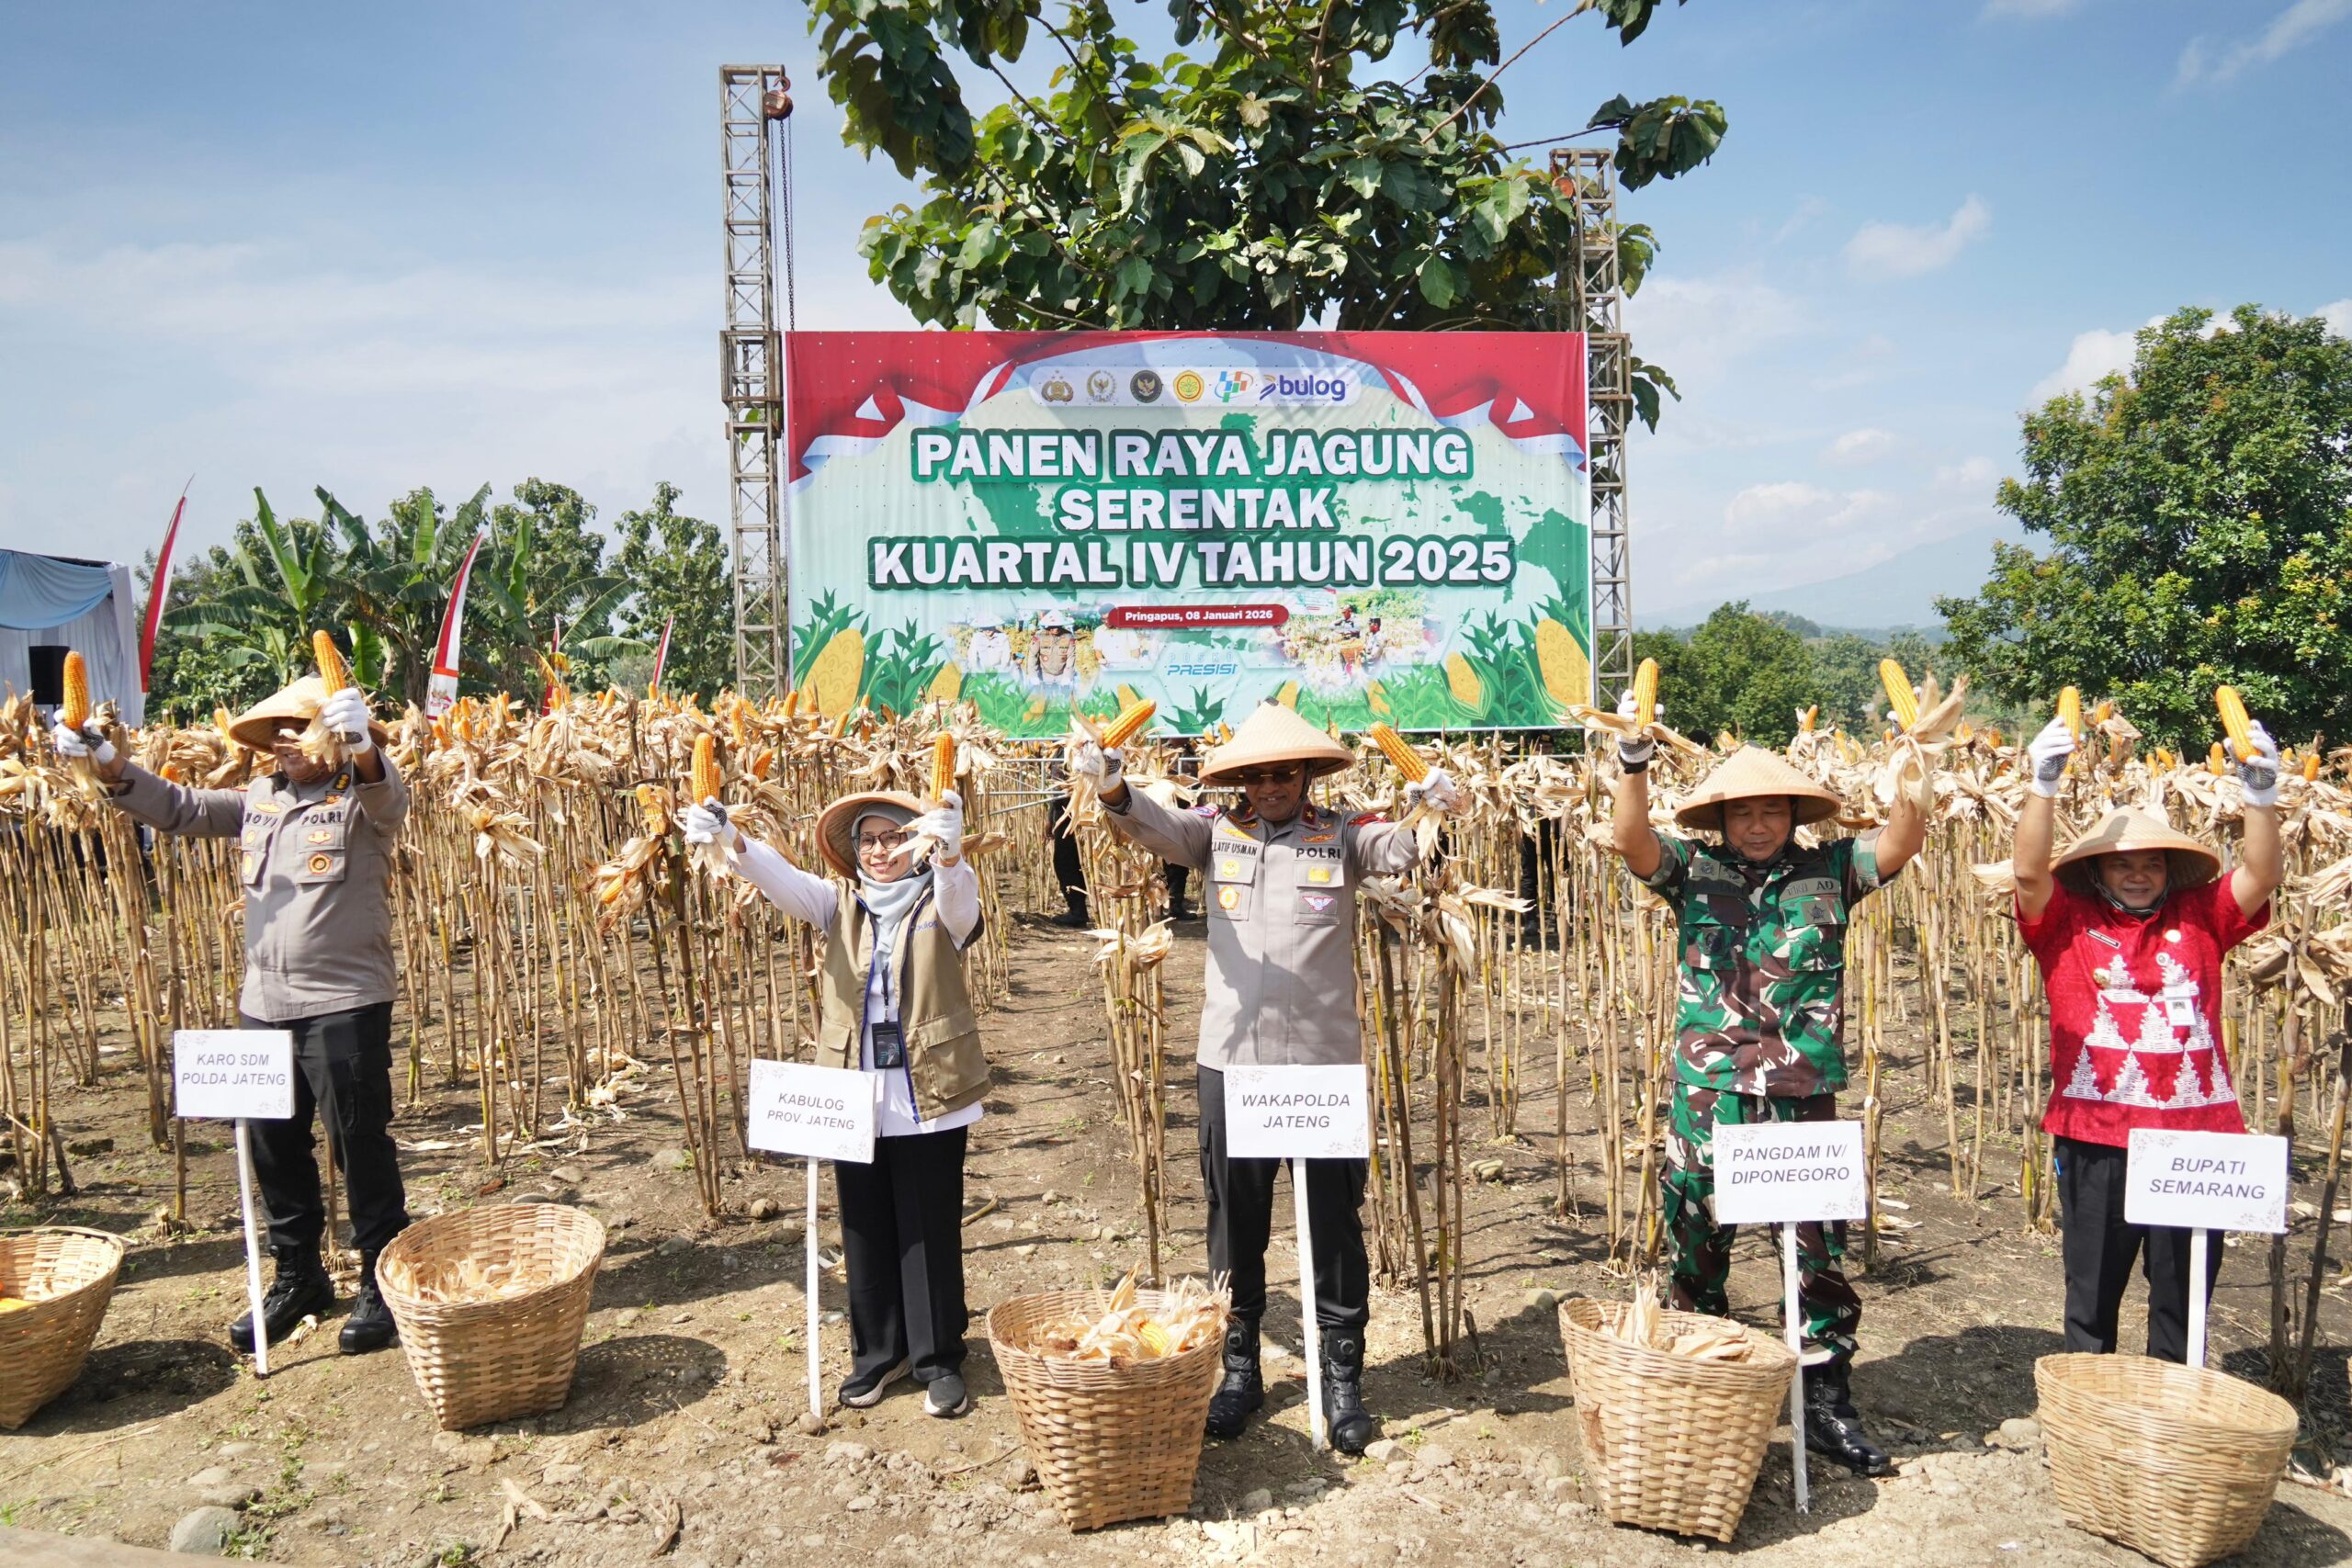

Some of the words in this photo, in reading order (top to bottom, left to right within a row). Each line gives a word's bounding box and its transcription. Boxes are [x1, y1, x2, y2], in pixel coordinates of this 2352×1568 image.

[1279, 375, 1345, 400] bulog
[919, 435, 1096, 476] PANEN
[1116, 435, 1250, 476] RAYA
[1265, 435, 1467, 476] JAGUNG
[1059, 489, 1334, 530] SERENTAK
[875, 543, 1116, 584] KUARTAL
[1133, 543, 1184, 582] IV
[1198, 542, 1367, 582] TAHUN
[1385, 540, 1511, 581] 2025
[1125, 611, 1183, 622] Pringapus,
[1185, 611, 1201, 620] 08
[1203, 610, 1243, 620] Januari
[1245, 609, 1273, 619] 2026
[1167, 663, 1238, 675] PRESISI
[301, 810, 343, 825] POLRI
[1231, 842, 1258, 856] USMAN
[1295, 847, 1341, 859] POLRI
[1815, 880, 1835, 891] AD
[197, 1054, 236, 1066] KARO
[240, 1054, 269, 1066] SDM
[182, 1072, 227, 1085] POLDA
[232, 1073, 286, 1086] JATENG
[778, 1092, 844, 1111] KABULOG
[1242, 1093, 1351, 1107] WAKAPOLDA
[767, 1110, 803, 1123] PROV.
[807, 1115, 854, 1130] JATENG
[1263, 1115, 1330, 1128] JATENG
[1733, 1145, 1821, 1161] PANGDAM
[1826, 1144, 1848, 1158] IV/
[2171, 1157, 2245, 1175] BUPATI
[1732, 1167, 1849, 1184] DIPONEGORO
[2150, 1179, 2266, 1200] SEMARANG
